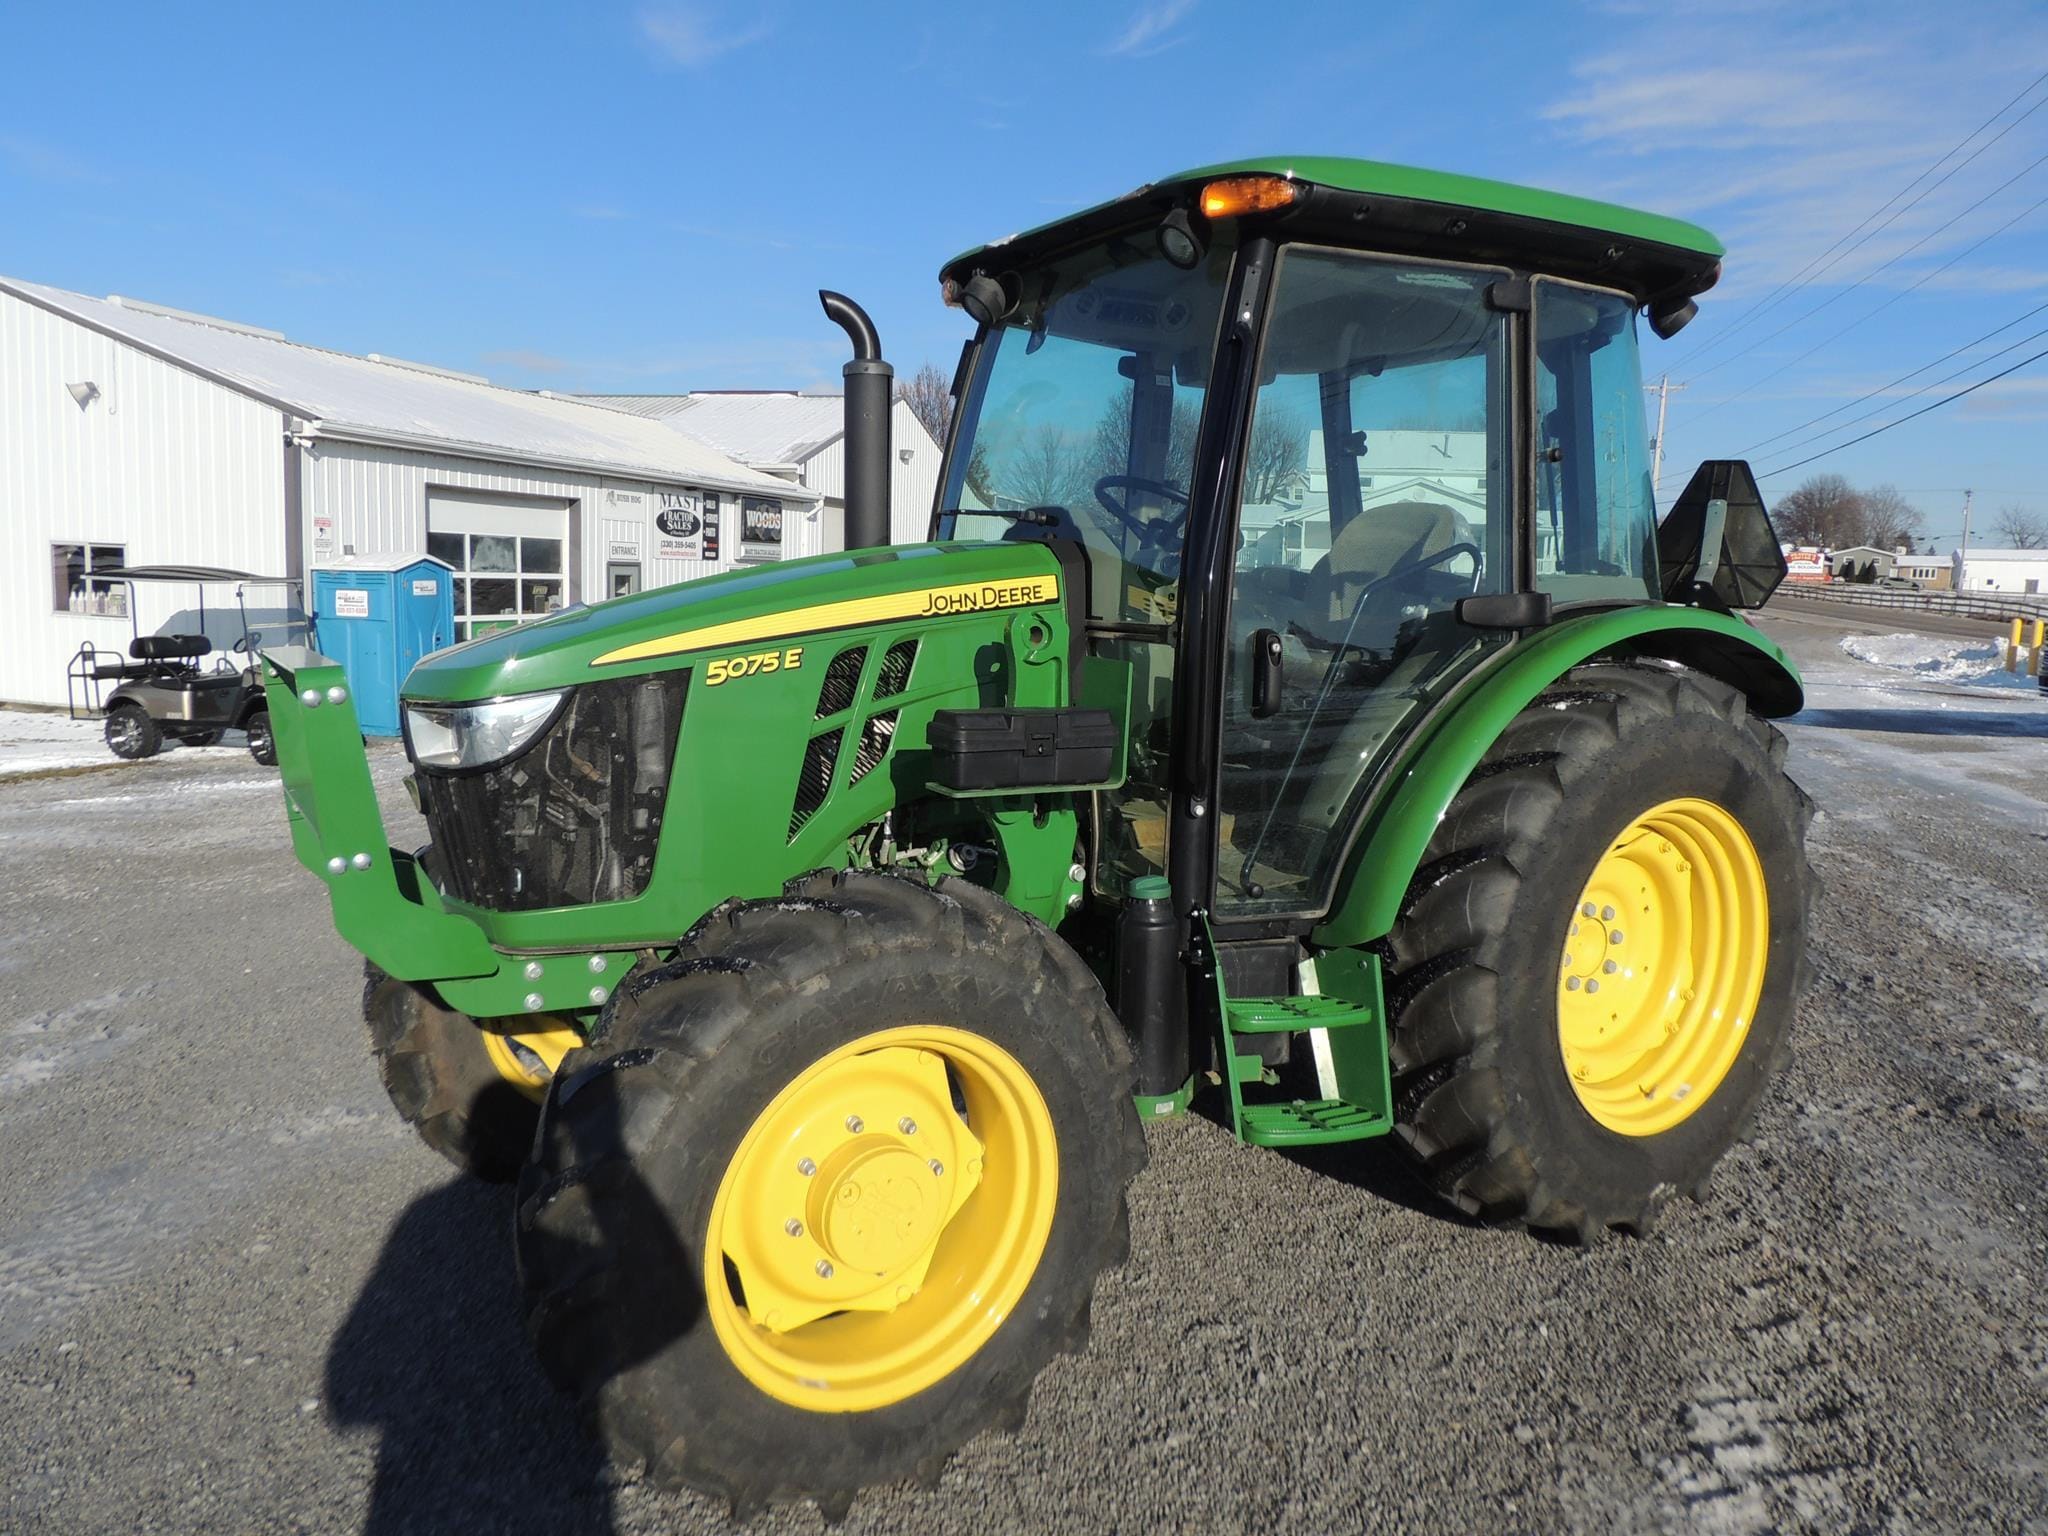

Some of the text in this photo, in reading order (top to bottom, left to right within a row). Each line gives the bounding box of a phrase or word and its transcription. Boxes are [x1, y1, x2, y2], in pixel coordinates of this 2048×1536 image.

[660, 493, 699, 511] MAST
[663, 510, 694, 522] TRACTOR
[746, 509, 781, 530] WOODS
[667, 520, 692, 531] SALES
[611, 545, 638, 556] ENTRANCE
[922, 585, 1043, 614] JOHN DEERE
[706, 648, 803, 686] 5075 E
